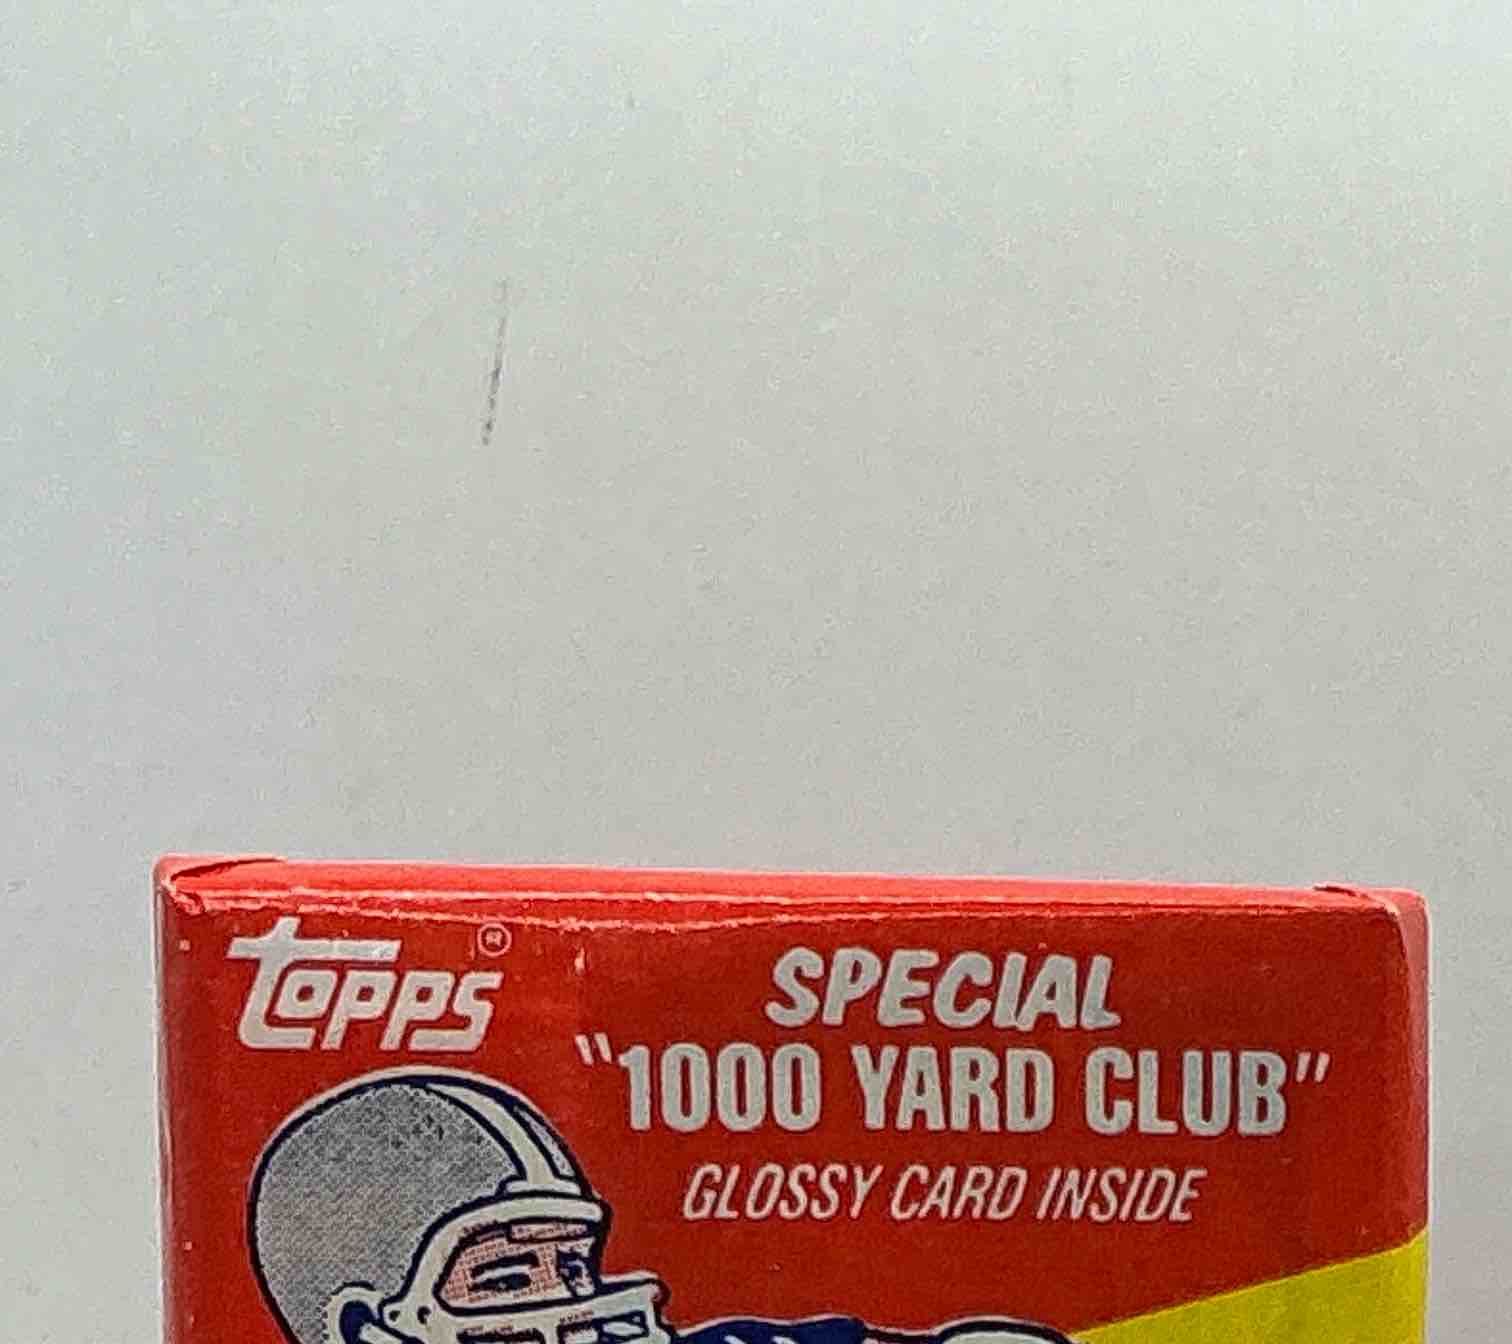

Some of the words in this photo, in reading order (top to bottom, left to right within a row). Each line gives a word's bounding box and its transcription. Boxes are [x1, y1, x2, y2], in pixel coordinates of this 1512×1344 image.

[764, 946, 1121, 1032] SPECIAL
[574, 1033, 822, 1135] "1000
[851, 1043, 1056, 1135] YARD
[1083, 1048, 1331, 1137] CLUB"
[682, 1161, 884, 1225] GLOSSY
[891, 1163, 1028, 1222] CARD
[1036, 1166, 1209, 1226] INSIDE
